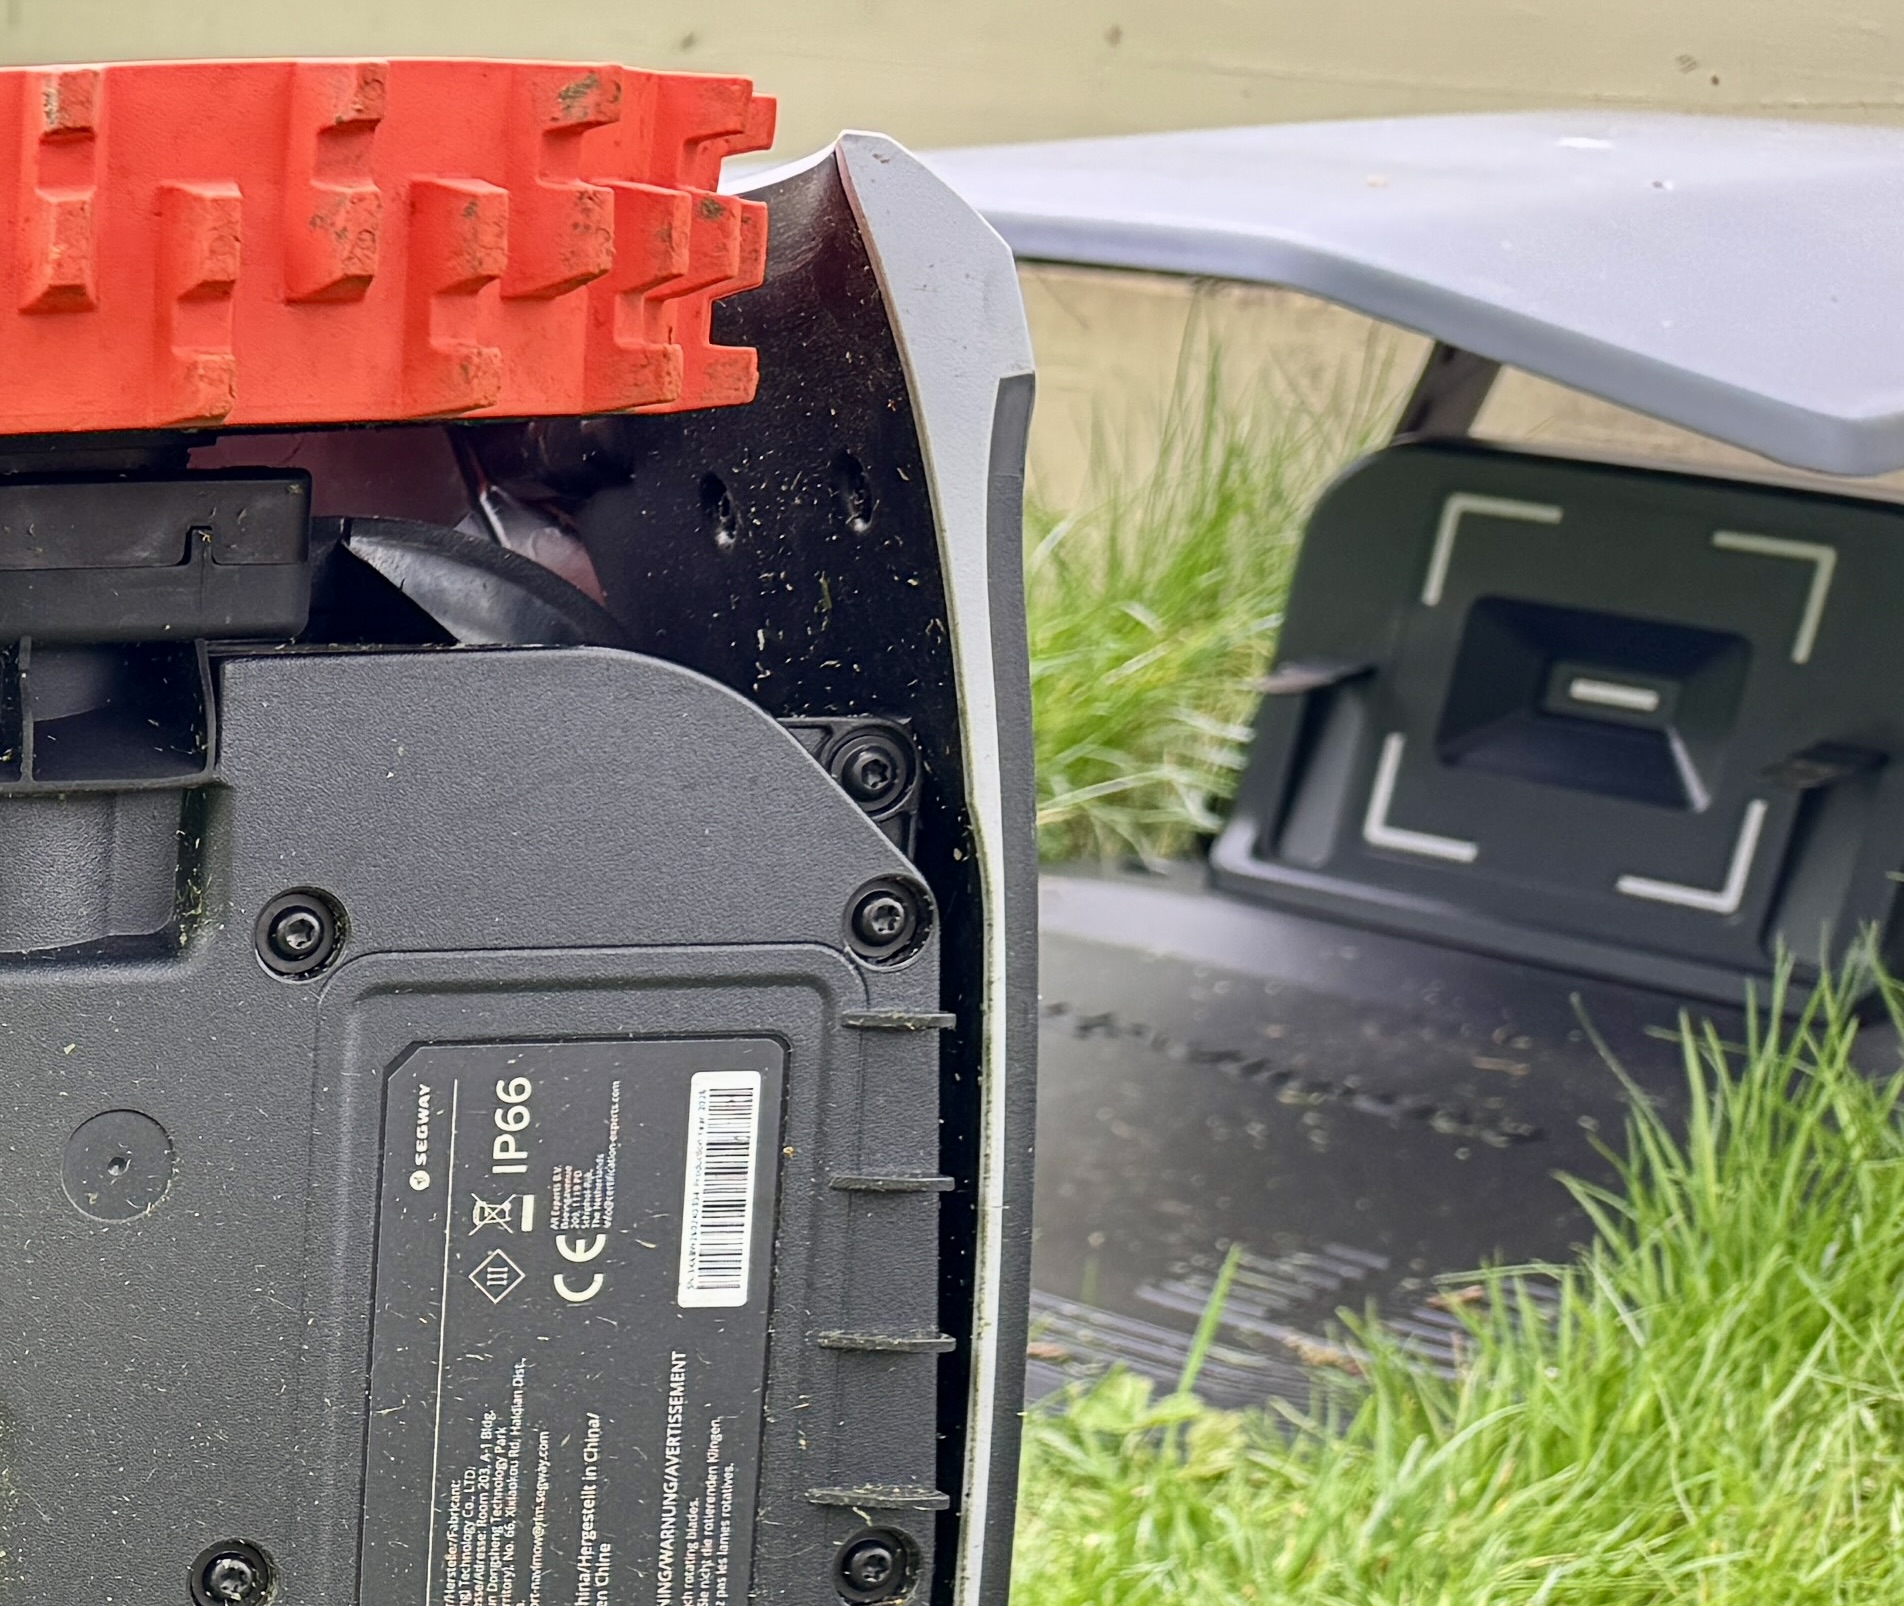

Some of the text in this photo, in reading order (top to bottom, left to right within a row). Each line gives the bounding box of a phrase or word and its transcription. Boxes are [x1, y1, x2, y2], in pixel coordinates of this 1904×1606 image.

[413, 1083, 431, 1166] SEGWAY
[490, 1076, 533, 1173] IP66
[509, 1390, 523, 1435] Haidian
[479, 1443, 491, 1462] A-1
[493, 1427, 506, 1453] Park
[582, 1412, 600, 1463] China/
[478, 1465, 492, 1490] 203,
[490, 1455, 507, 1522] Technology
[581, 1466, 597, 1480] in
[719, 1463, 734, 1517] rotatives.
[476, 1492, 489, 1527] Room
[685, 1497, 699, 1539] blades.
[701, 1465, 717, 1535] rotierenden
[503, 1519, 517, 1537] 66,
[700, 1538, 713, 1556] die
[717, 1520, 730, 1555] lames
[458, 1520, 476, 1587] Technology
[486, 1524, 504, 1592] Dongsheng
[502, 1540, 515, 1560] No.
[594, 1543, 611, 1586] Chine
[682, 1542, 699, 1589] rotating
[716, 1558, 728, 1574] les
[698, 1559, 711, 1588] nicht
[714, 1577, 729, 1597] pas
